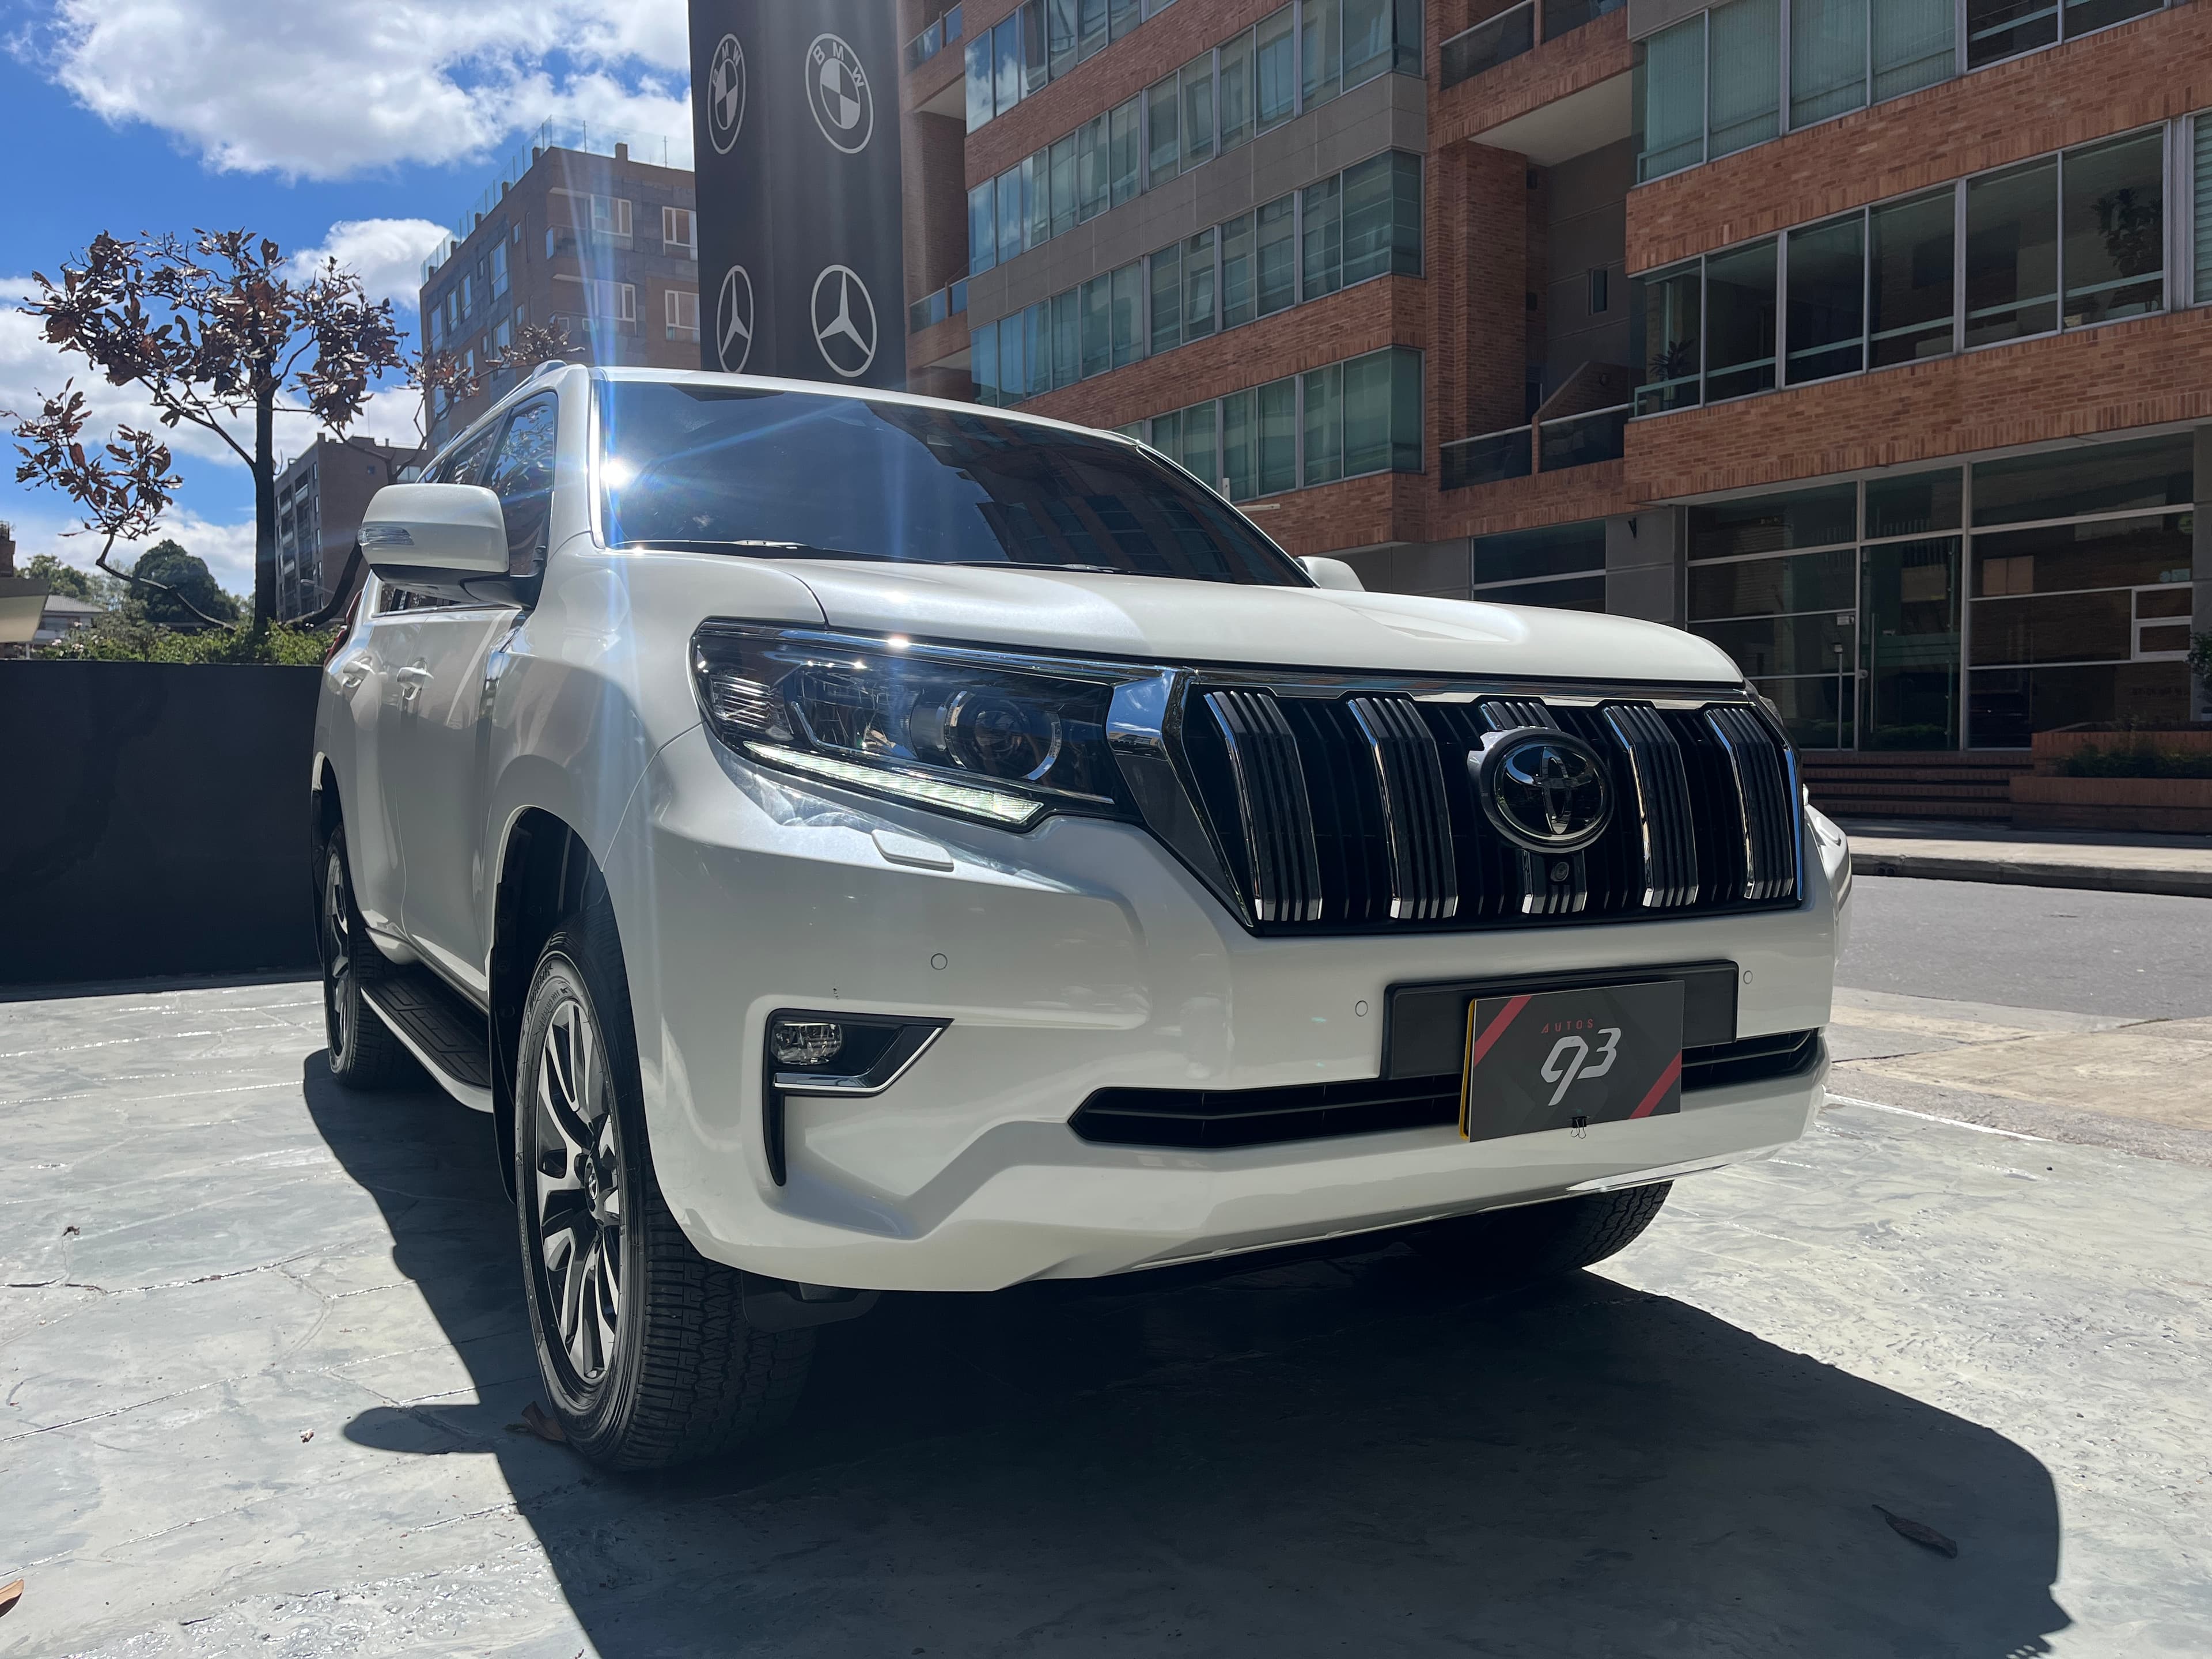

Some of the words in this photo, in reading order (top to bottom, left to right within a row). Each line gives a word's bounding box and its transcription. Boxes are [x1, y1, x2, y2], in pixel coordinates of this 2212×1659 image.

[813, 41, 865, 88] BMW
[1541, 1018, 1594, 1034] AUTOS
[1540, 1027, 1622, 1107] 93
